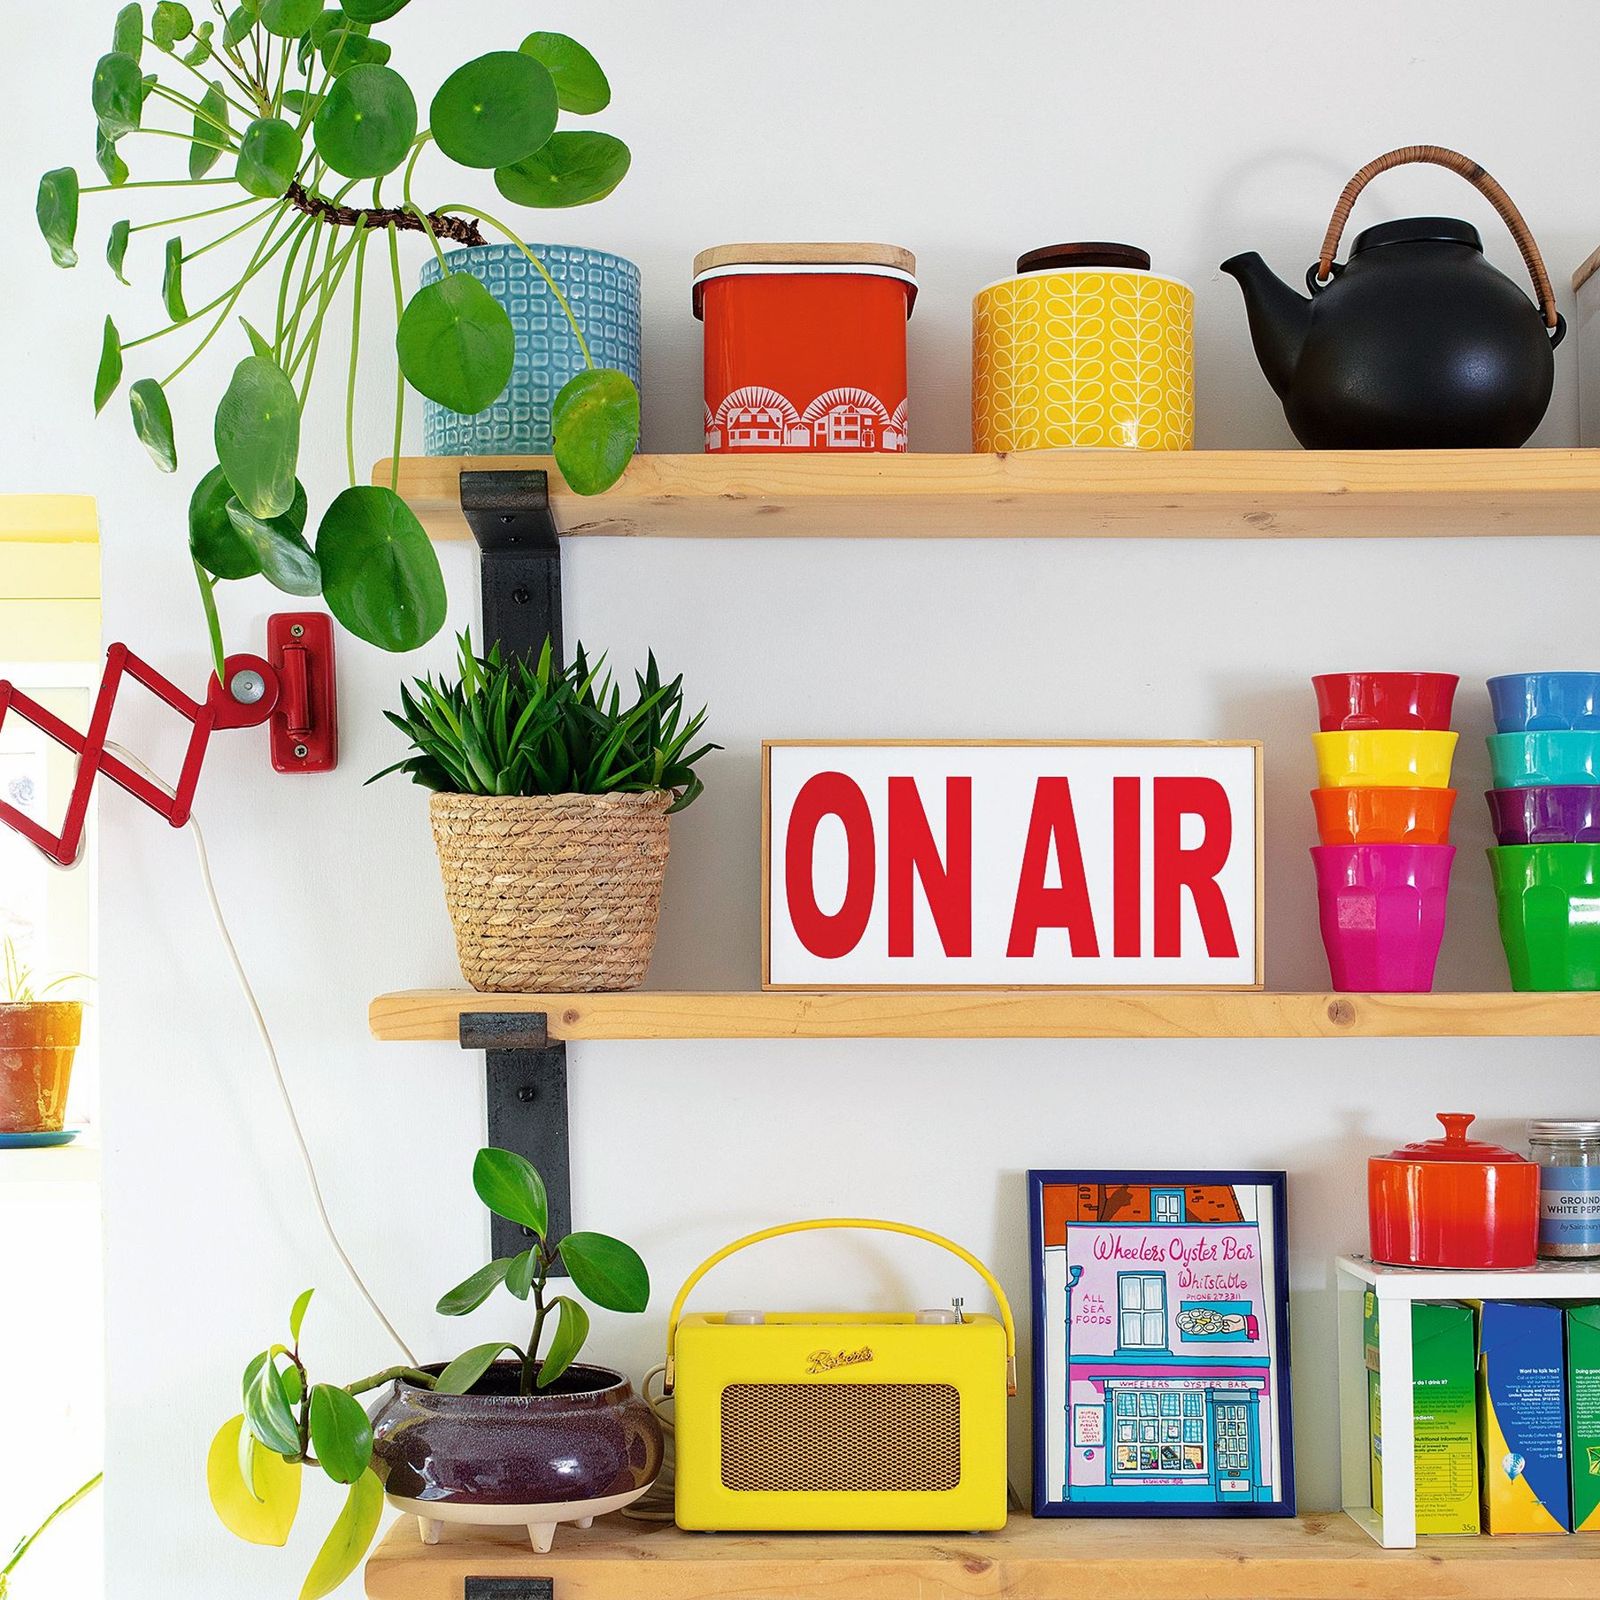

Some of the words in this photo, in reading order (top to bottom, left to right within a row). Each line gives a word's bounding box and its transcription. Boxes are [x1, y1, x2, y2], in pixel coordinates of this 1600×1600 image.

[785, 771, 972, 959] ON
[1005, 776, 1240, 958] AIR
[1560, 1196, 1600, 1205] GROUND
[1547, 1205, 1578, 1214] WHITE
[1093, 1233, 1166, 1262] Wheelers
[1169, 1236, 1218, 1268] Oyster
[1221, 1236, 1255, 1261] Bar
[1178, 1268, 1248, 1290] Whitstable
[1082, 1293, 1105, 1303] ALL
[1213, 1292, 1241, 1301] 273311
[1082, 1304, 1105, 1314] SEA
[1075, 1315, 1112, 1325] FOODS
[1119, 1380, 1170, 1388] WHEELERS
[1183, 1380, 1222, 1388] OYSTER
[1228, 1380, 1249, 1388] BAR
[1462, 1523, 1476, 1532] 35g
